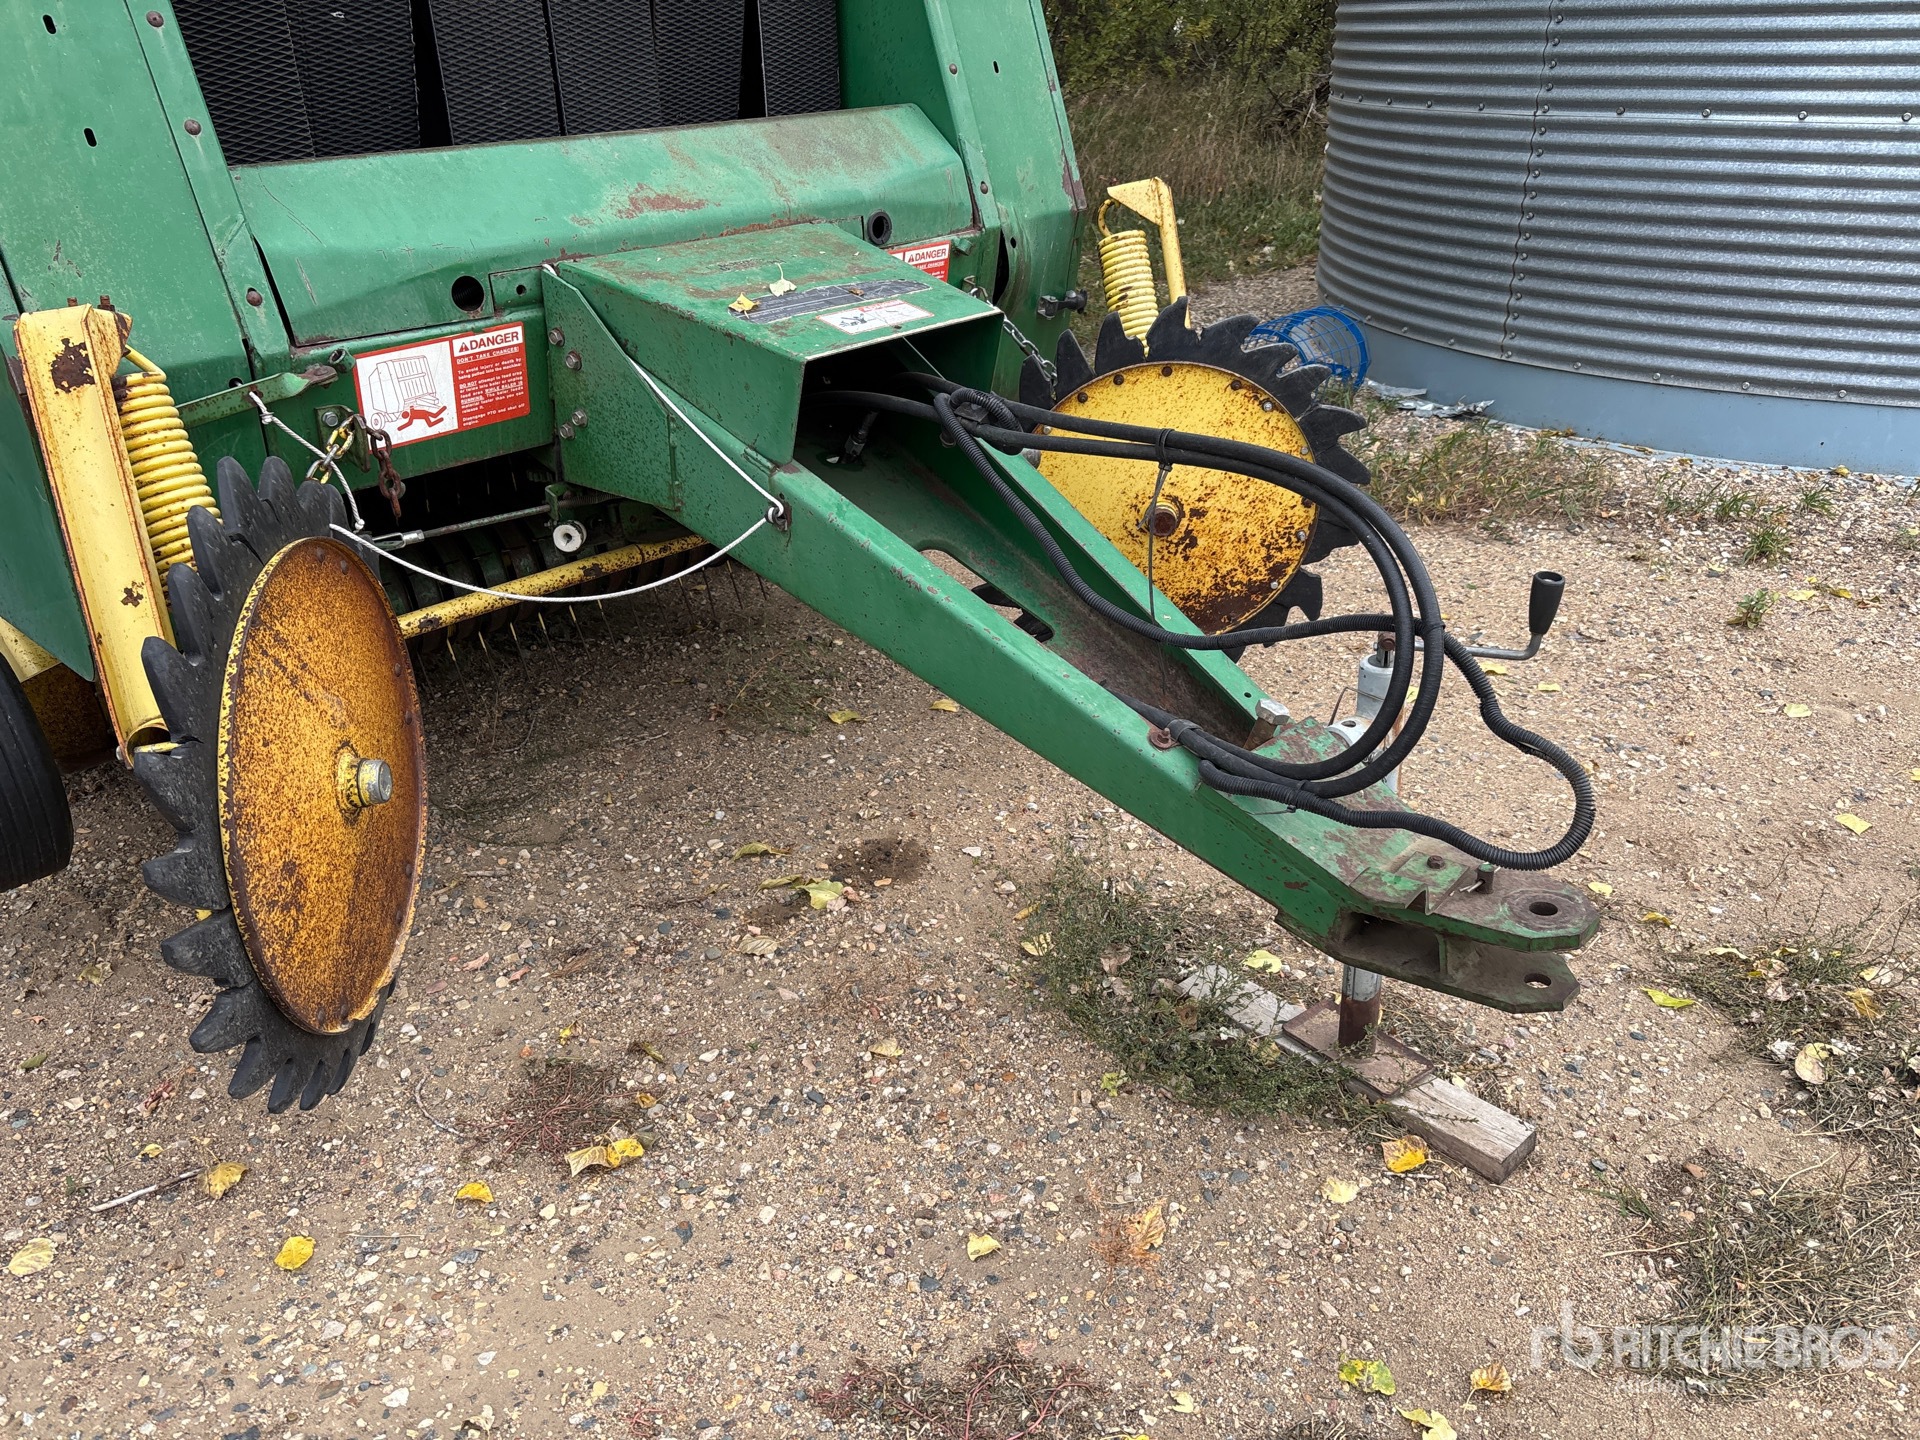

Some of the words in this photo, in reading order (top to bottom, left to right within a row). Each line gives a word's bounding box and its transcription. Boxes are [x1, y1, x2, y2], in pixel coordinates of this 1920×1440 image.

[915, 248, 946, 261] DANGER
[470, 331, 519, 350] DANGER
[457, 355, 473, 364] DON'T
[463, 413, 486, 421] Disengage
